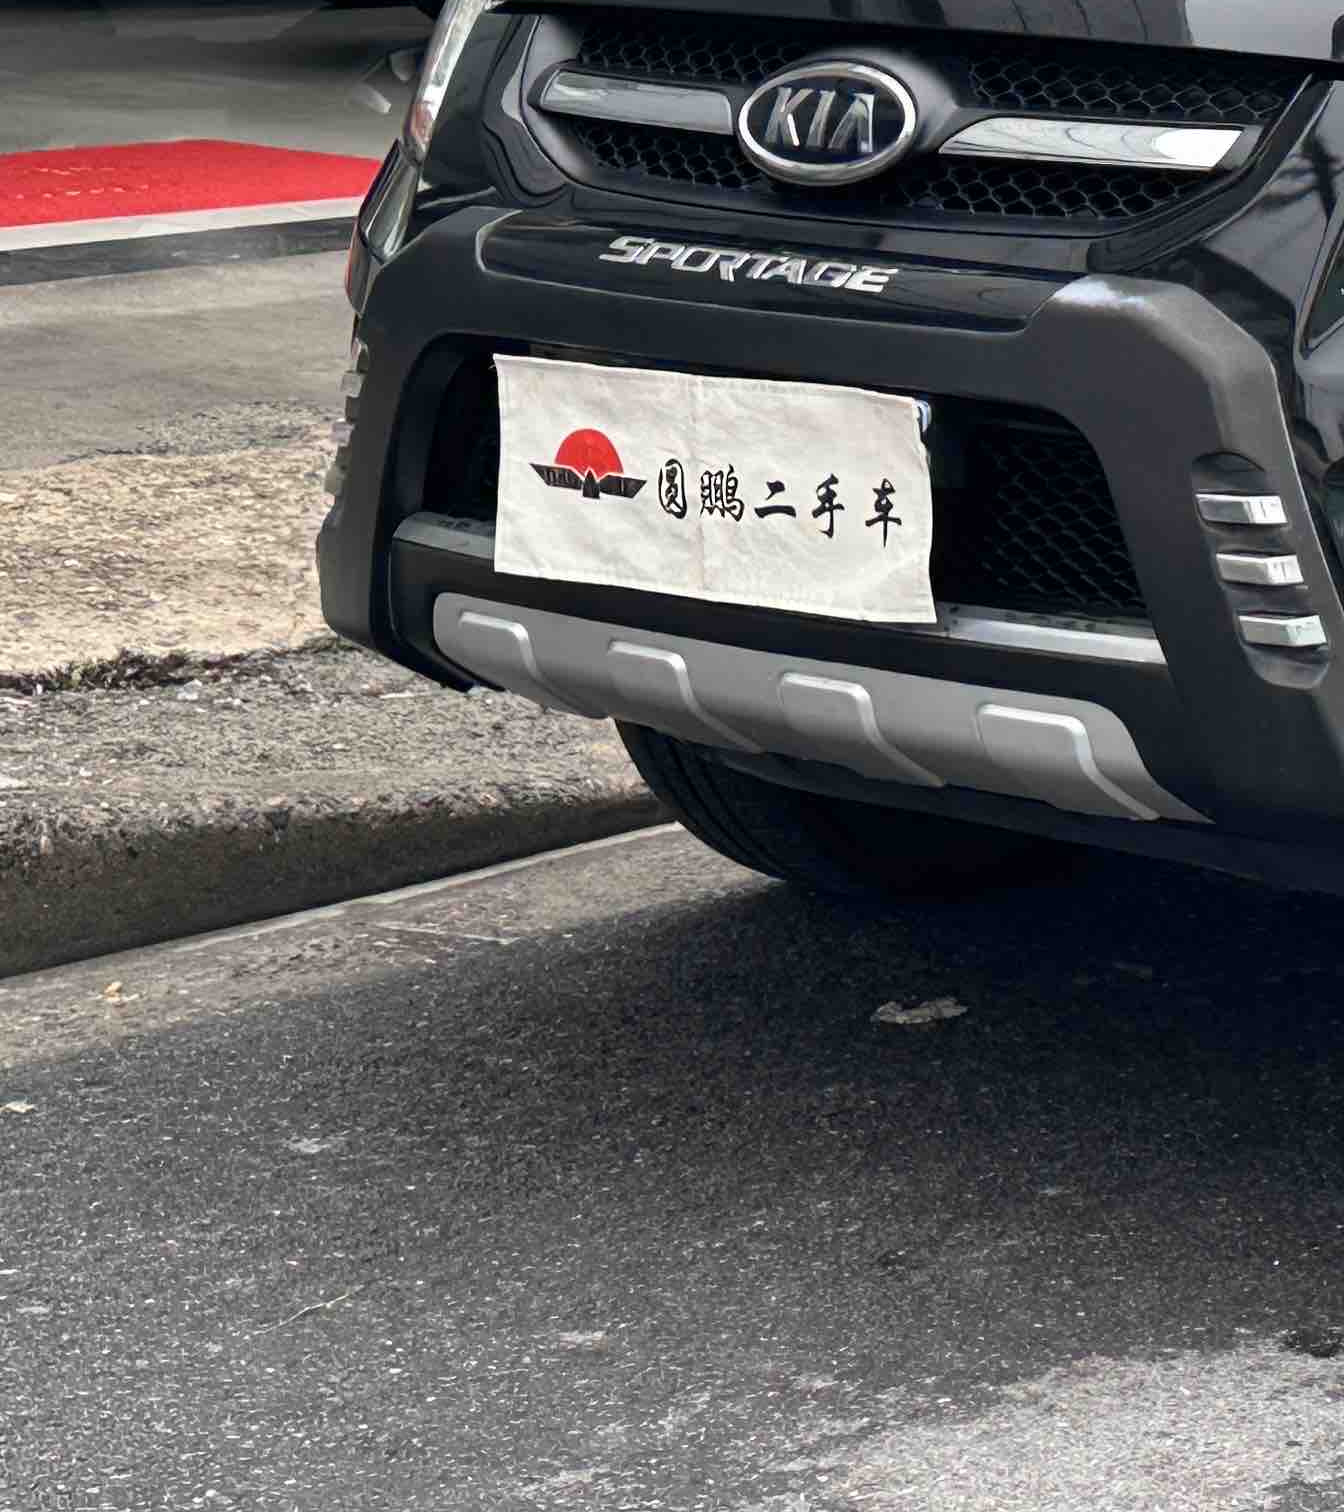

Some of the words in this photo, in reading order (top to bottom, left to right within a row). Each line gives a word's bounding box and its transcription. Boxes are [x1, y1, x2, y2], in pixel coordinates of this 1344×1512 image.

[764, 87, 875, 153] KIA
[599, 235, 899, 293] SPORTAGE
[658, 458, 902, 548] 圆鹏二手车
